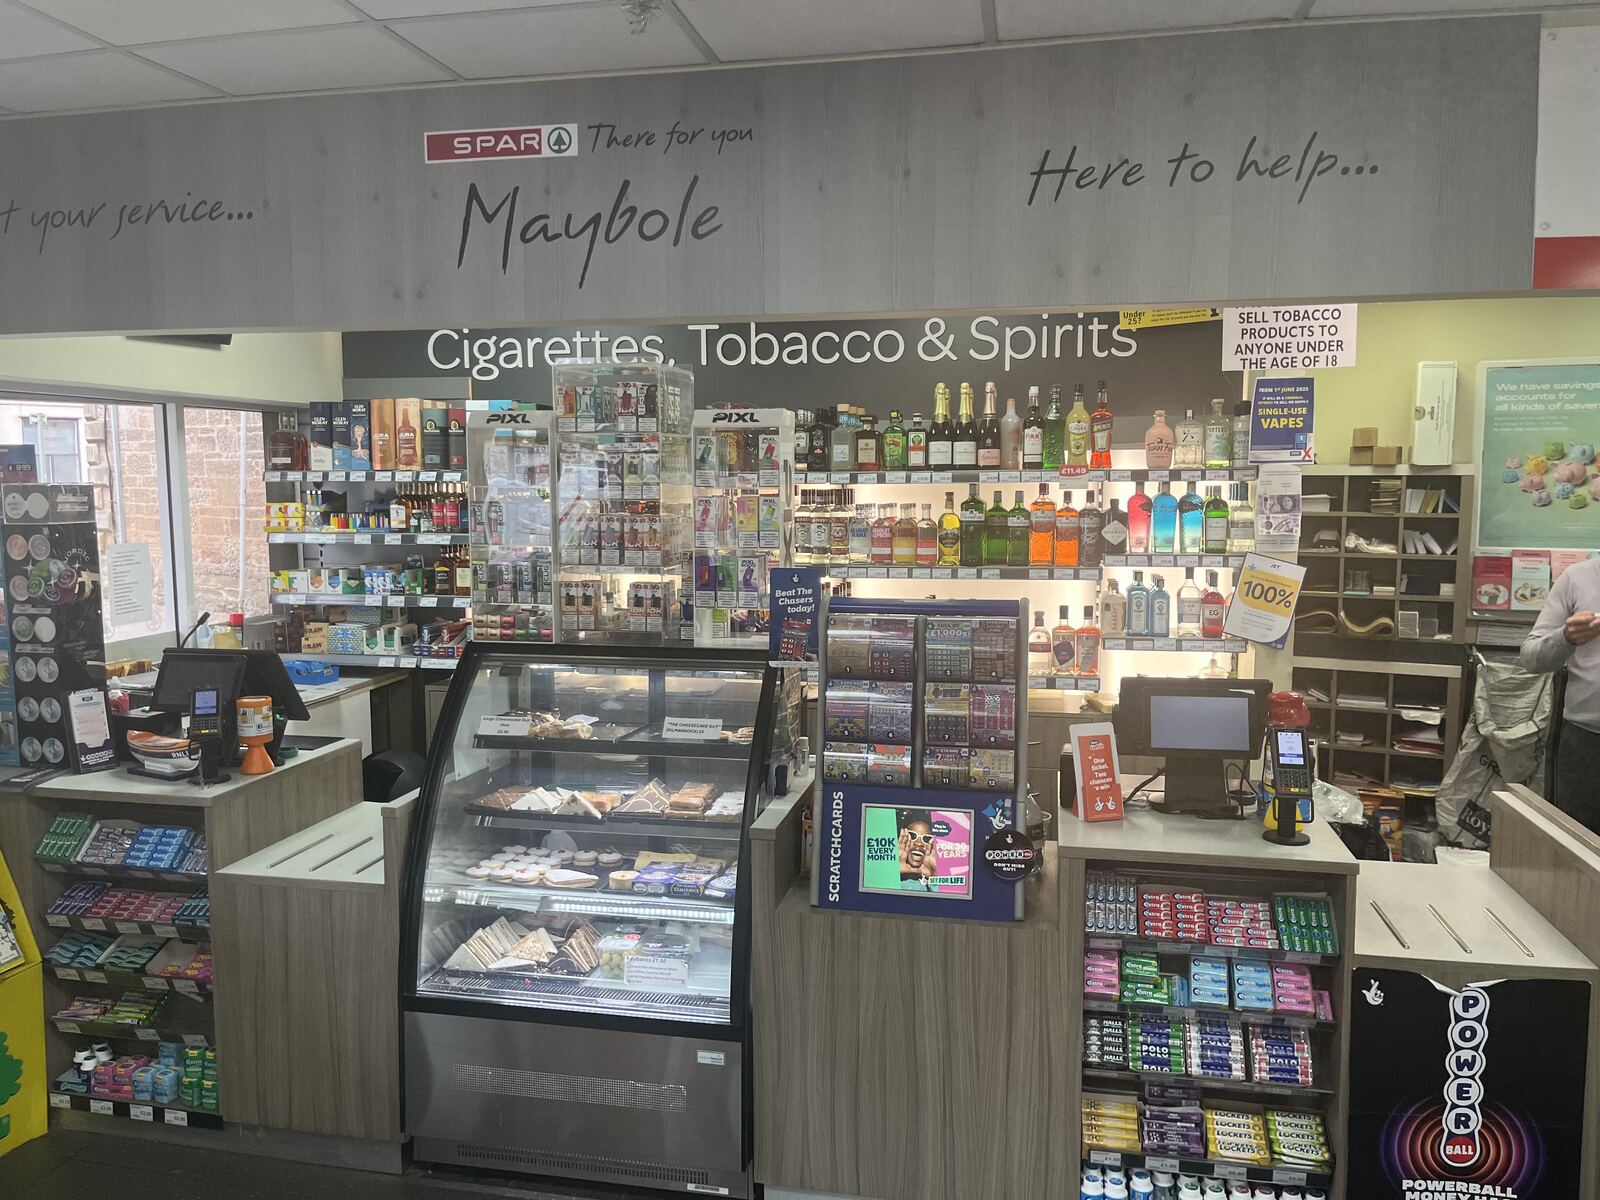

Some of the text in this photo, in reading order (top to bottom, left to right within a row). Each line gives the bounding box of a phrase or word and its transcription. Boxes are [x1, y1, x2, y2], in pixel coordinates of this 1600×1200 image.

[453, 133, 540, 154] SPAR
[587, 121, 754, 162] There for you
[1028, 131, 1380, 206] Here to help...
[30, 198, 106, 255] your
[110, 191, 255, 240] service...
[457, 174, 724, 290] Maybole
[1123, 310, 1146, 319] Under
[1238, 308, 1342, 324] SELL TOBACCO
[1240, 324, 1338, 340] PRODUCTS TO
[426, 311, 1138, 381] Cigarettes, Tobacco & Spirits
[1234, 339, 1344, 356] ANYONE UNDER
[1240, 354, 1338, 370] THE AGE OF 18
[1496, 383, 1518, 392] We
[1553, 380, 1600, 391] savings
[1495, 391, 1577, 402] accounts for
[1257, 407, 1308, 416] SINGLE-USE
[1494, 403, 1508, 412] all
[1510, 402, 1545, 411] kinds
[1547, 402, 1562, 410] of
[486, 413, 532, 424] PIXL
[711, 412, 761, 423] PIXL
[1261, 417, 1304, 429] VAPES
[1061, 467, 1087, 475] £11.49
[775, 587, 813, 597] Beat The
[1243, 581, 1294, 609] 100%
[778, 596, 813, 605] Chasers
[787, 604, 815, 613] today!
[171, 750, 189, 759] RNLI
[828, 791, 844, 903] SCRATCHCARDS
[866, 837, 896, 848] £10K
[936, 850, 967, 859] YEARS
[949, 877, 965, 885] LIFE
[1141, 1045, 1169, 1054] POLO
[1453, 994, 1481, 1130] POWER
[1214, 1111, 1250, 1120] LOCKETS
[1276, 1111, 1312, 1120] LOCKETS
[1216, 1121, 1251, 1130] LOCKETS
[1277, 1121, 1314, 1131] LOCKETS
[1217, 1130, 1252, 1139] LOCKETS
[1278, 1131, 1315, 1141] LOCKETS
[1220, 1145, 1256, 1154] LOCKETS
[1445, 1144, 1474, 1155] BALL
[1402, 1179, 1518, 1198] POWERBALL
[1405, 1191, 1470, 1200] MONEY
